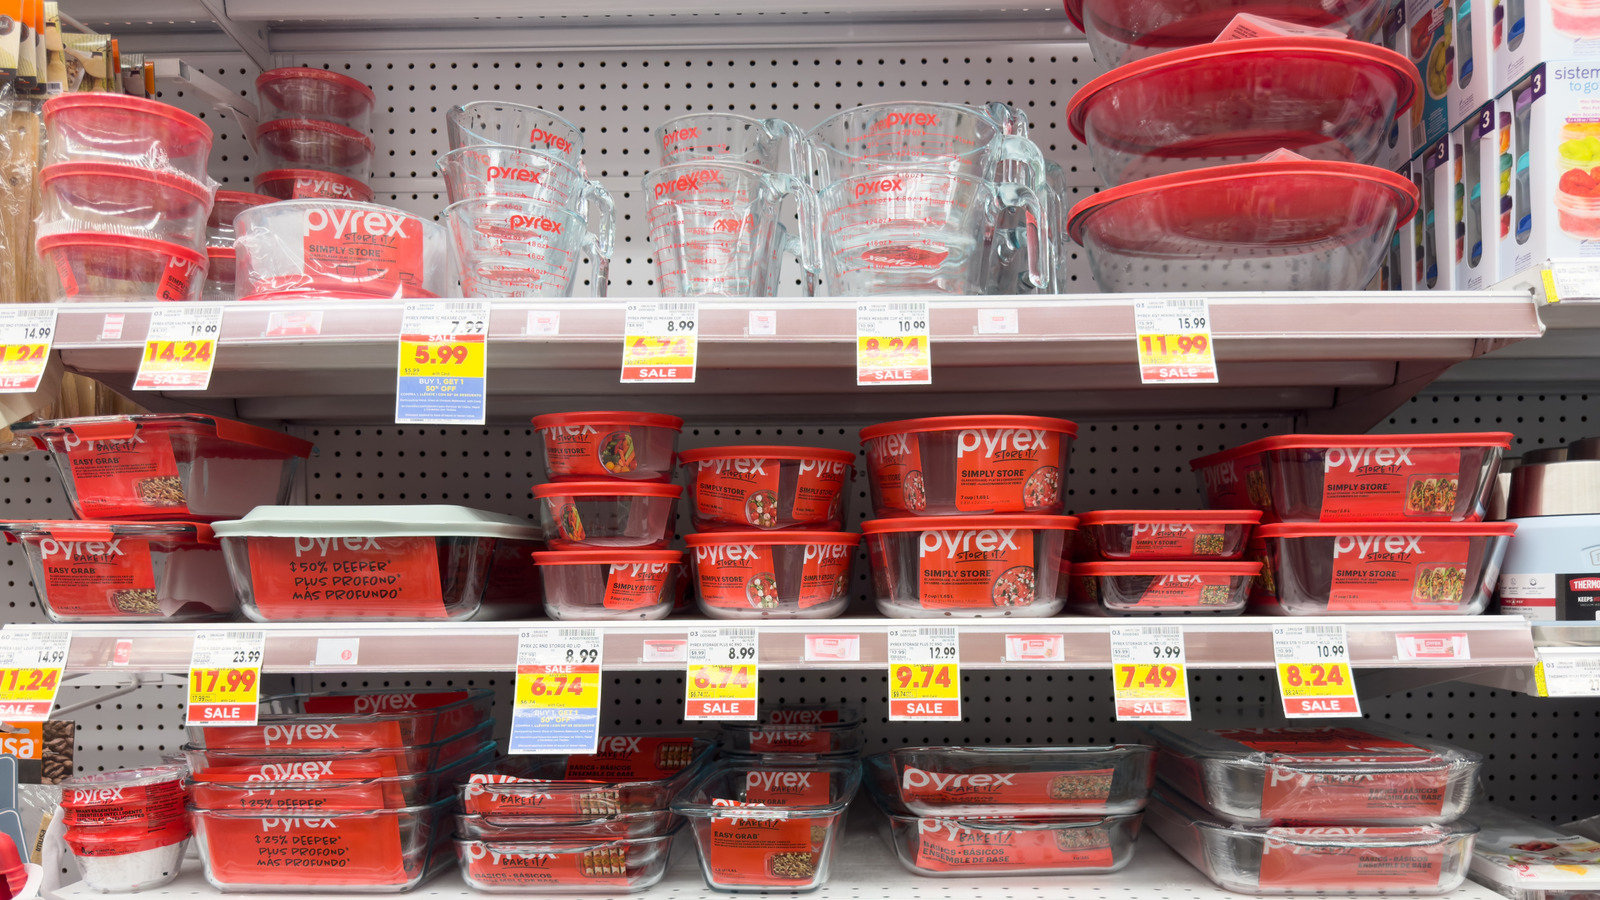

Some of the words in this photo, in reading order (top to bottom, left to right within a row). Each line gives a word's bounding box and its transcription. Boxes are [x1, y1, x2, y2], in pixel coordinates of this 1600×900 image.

[1534, 74, 1541, 93] 3
[1570, 82, 1581, 91] to
[1584, 82, 1598, 94] go
[886, 112, 937, 128] pyrex
[1482, 111, 1490, 128] 3
[530, 128, 571, 154] pyrex
[663, 127, 698, 150] pyrex
[1438, 143, 1444, 158] 3
[487, 166, 541, 184] pyrex
[655, 176, 698, 200] pyrex
[856, 179, 902, 199] pyrex
[304, 209, 406, 239] pyrex
[510, 214, 562, 234] pyrex
[309, 244, 346, 256] SIMPLY
[348, 248, 382, 258] STORE
[667, 321, 695, 332] 8.99
[1178, 318, 1206, 329] 15.99
[23, 328, 51, 339] 14.99
[149, 342, 211, 362] 14.24
[632, 338, 687, 356] 6.74
[866, 338, 920, 358] 8.24
[1142, 335, 1208, 356] 11.99
[415, 345, 468, 365] 5.99
[153, 375, 192, 385] SALE
[639, 369, 677, 377] SALE
[875, 370, 912, 379] SALE
[1159, 368, 1198, 377] SALE
[96, 441, 122, 452] BAKE
[957, 428, 1047, 458] pyrex
[73, 458, 93, 466] EASY
[698, 459, 766, 476] pyrex
[1324, 447, 1412, 473] pyrex
[996, 469, 1024, 477] STORE
[700, 483, 722, 492] SIMPLY
[723, 487, 745, 496] STORE
[40, 539, 123, 560] pyrex
[919, 530, 1017, 559] pyrex
[1334, 536, 1421, 559] pyrex
[73, 554, 99, 563] BAKE
[696, 545, 758, 565] pyrex
[299, 561, 328, 573] 50%
[333, 561, 387, 573] DEEPER
[295, 576, 327, 587] PLUS
[332, 575, 396, 586] PROFOND
[613, 583, 639, 591] SIMPLY
[326, 589, 397, 600] PROFUNDO
[38, 651, 65, 663] 14.99
[233, 651, 260, 663] 23.99
[566, 649, 598, 663] 8.99
[729, 648, 755, 659] 8.99
[1153, 646, 1180, 658] 9.99
[1317, 646, 1344, 658] 10.99
[545, 665, 572, 673] SALE
[1287, 665, 1344, 687] 8.24
[194, 670, 256, 692] 17.99
[694, 667, 749, 688] 6.74
[897, 666, 951, 688] 9.74
[1122, 666, 1177, 688] 7.49
[531, 677, 583, 696] 6.74
[354, 693, 416, 713] pyrex
[703, 703, 739, 713] SALE
[907, 703, 943, 713] SALE
[1134, 703, 1170, 713] SALE
[1301, 700, 1340, 711] SALE
[204, 708, 240, 718] SALE
[263, 724, 338, 745] pyrex
[746, 771, 810, 791] pyrex
[903, 768, 1015, 791] pyrex
[73, 788, 123, 804] pyrex
[264, 835, 288, 845] 25%
[293, 836, 338, 845] DEEPER
[259, 848, 287, 856] PLUS
[292, 848, 346, 856] PROFOND
[923, 848, 970, 864] ENSEMBLE
[285, 859, 346, 867] PROFUNDO
[503, 857, 531, 867] BAKE
